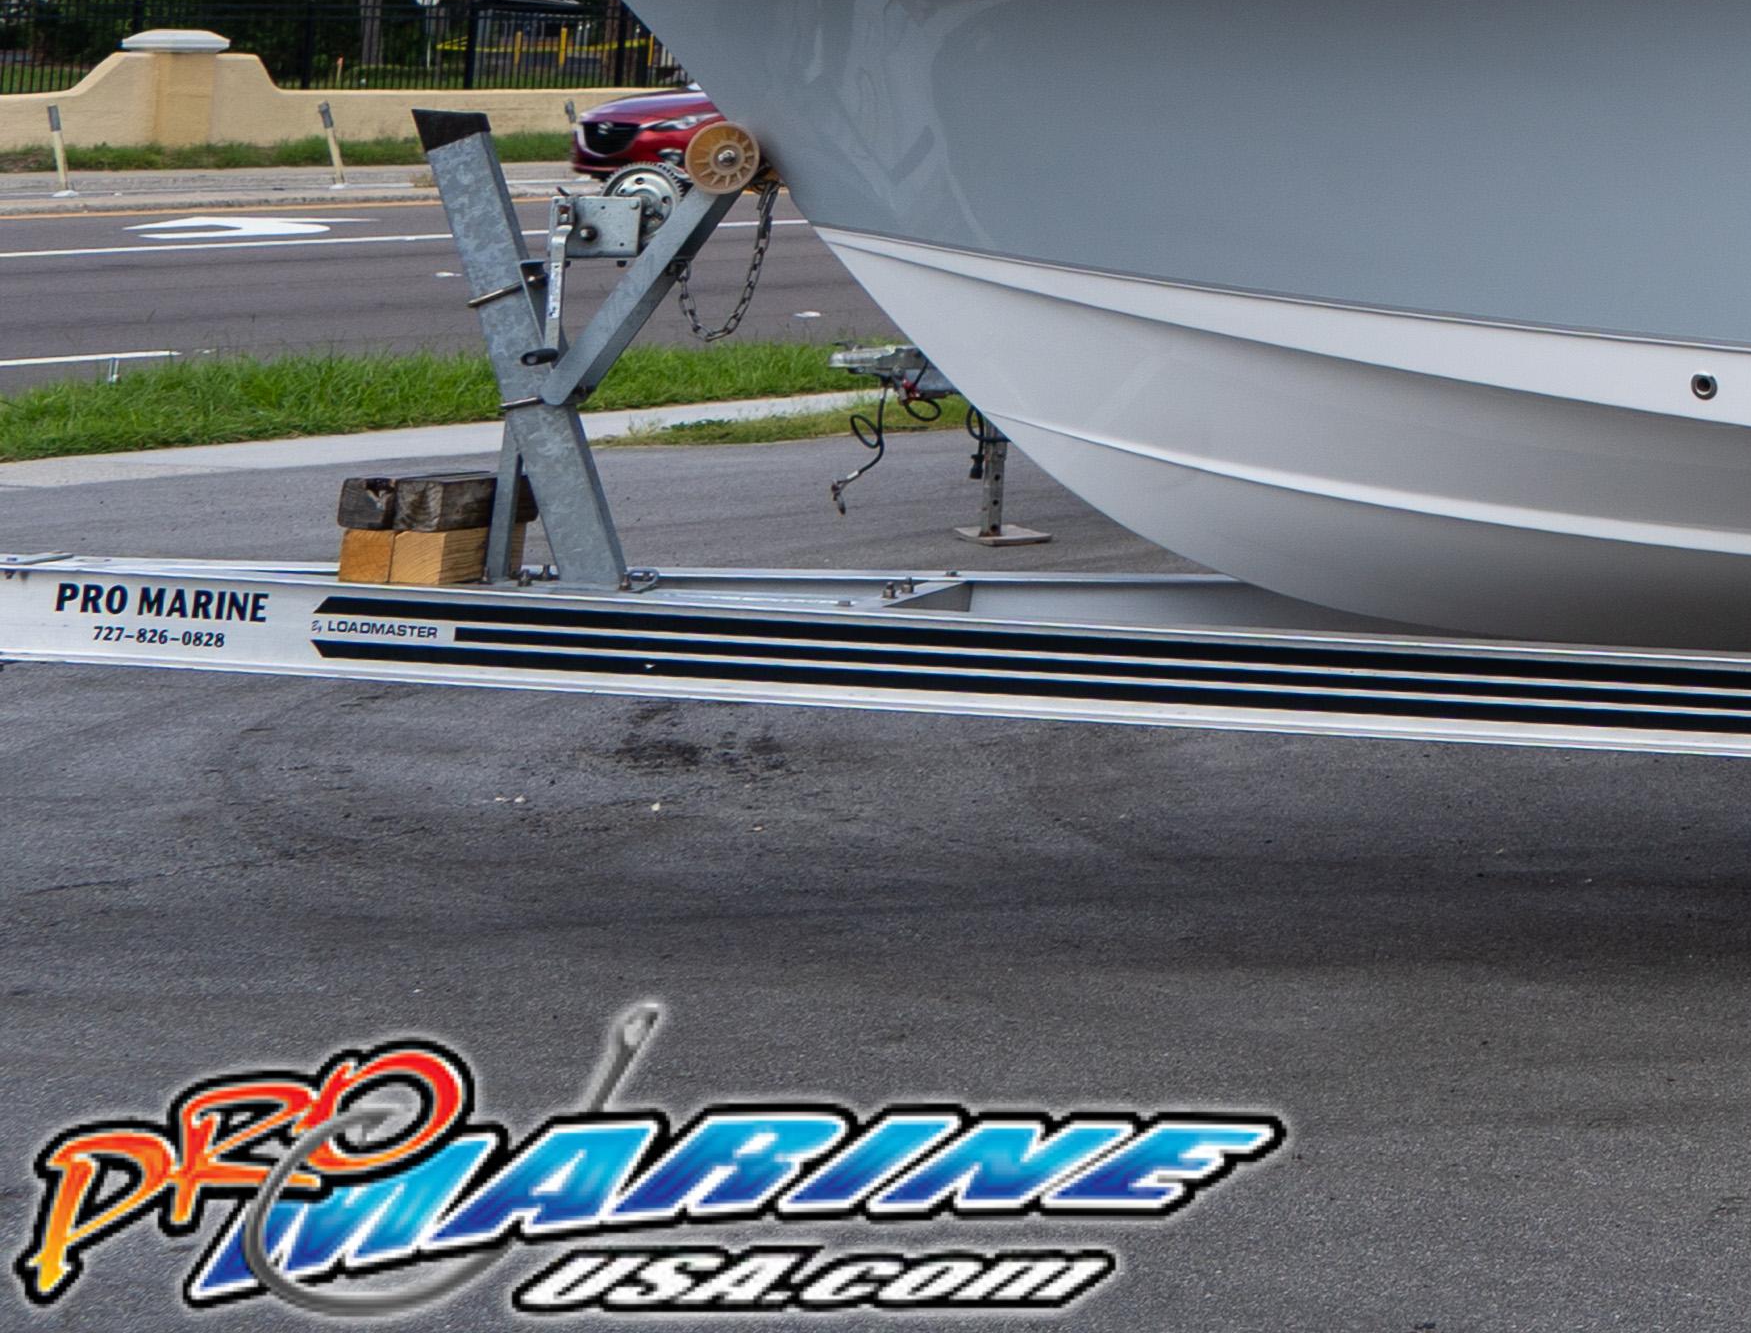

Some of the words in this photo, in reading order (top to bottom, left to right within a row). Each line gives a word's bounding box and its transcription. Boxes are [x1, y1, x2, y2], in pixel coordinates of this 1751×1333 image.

[55, 582, 129, 615] PRO
[138, 587, 270, 623] MARINE
[92, 625, 226, 648] 727-826-0828
[327, 619, 438, 639] LOADMASTER
